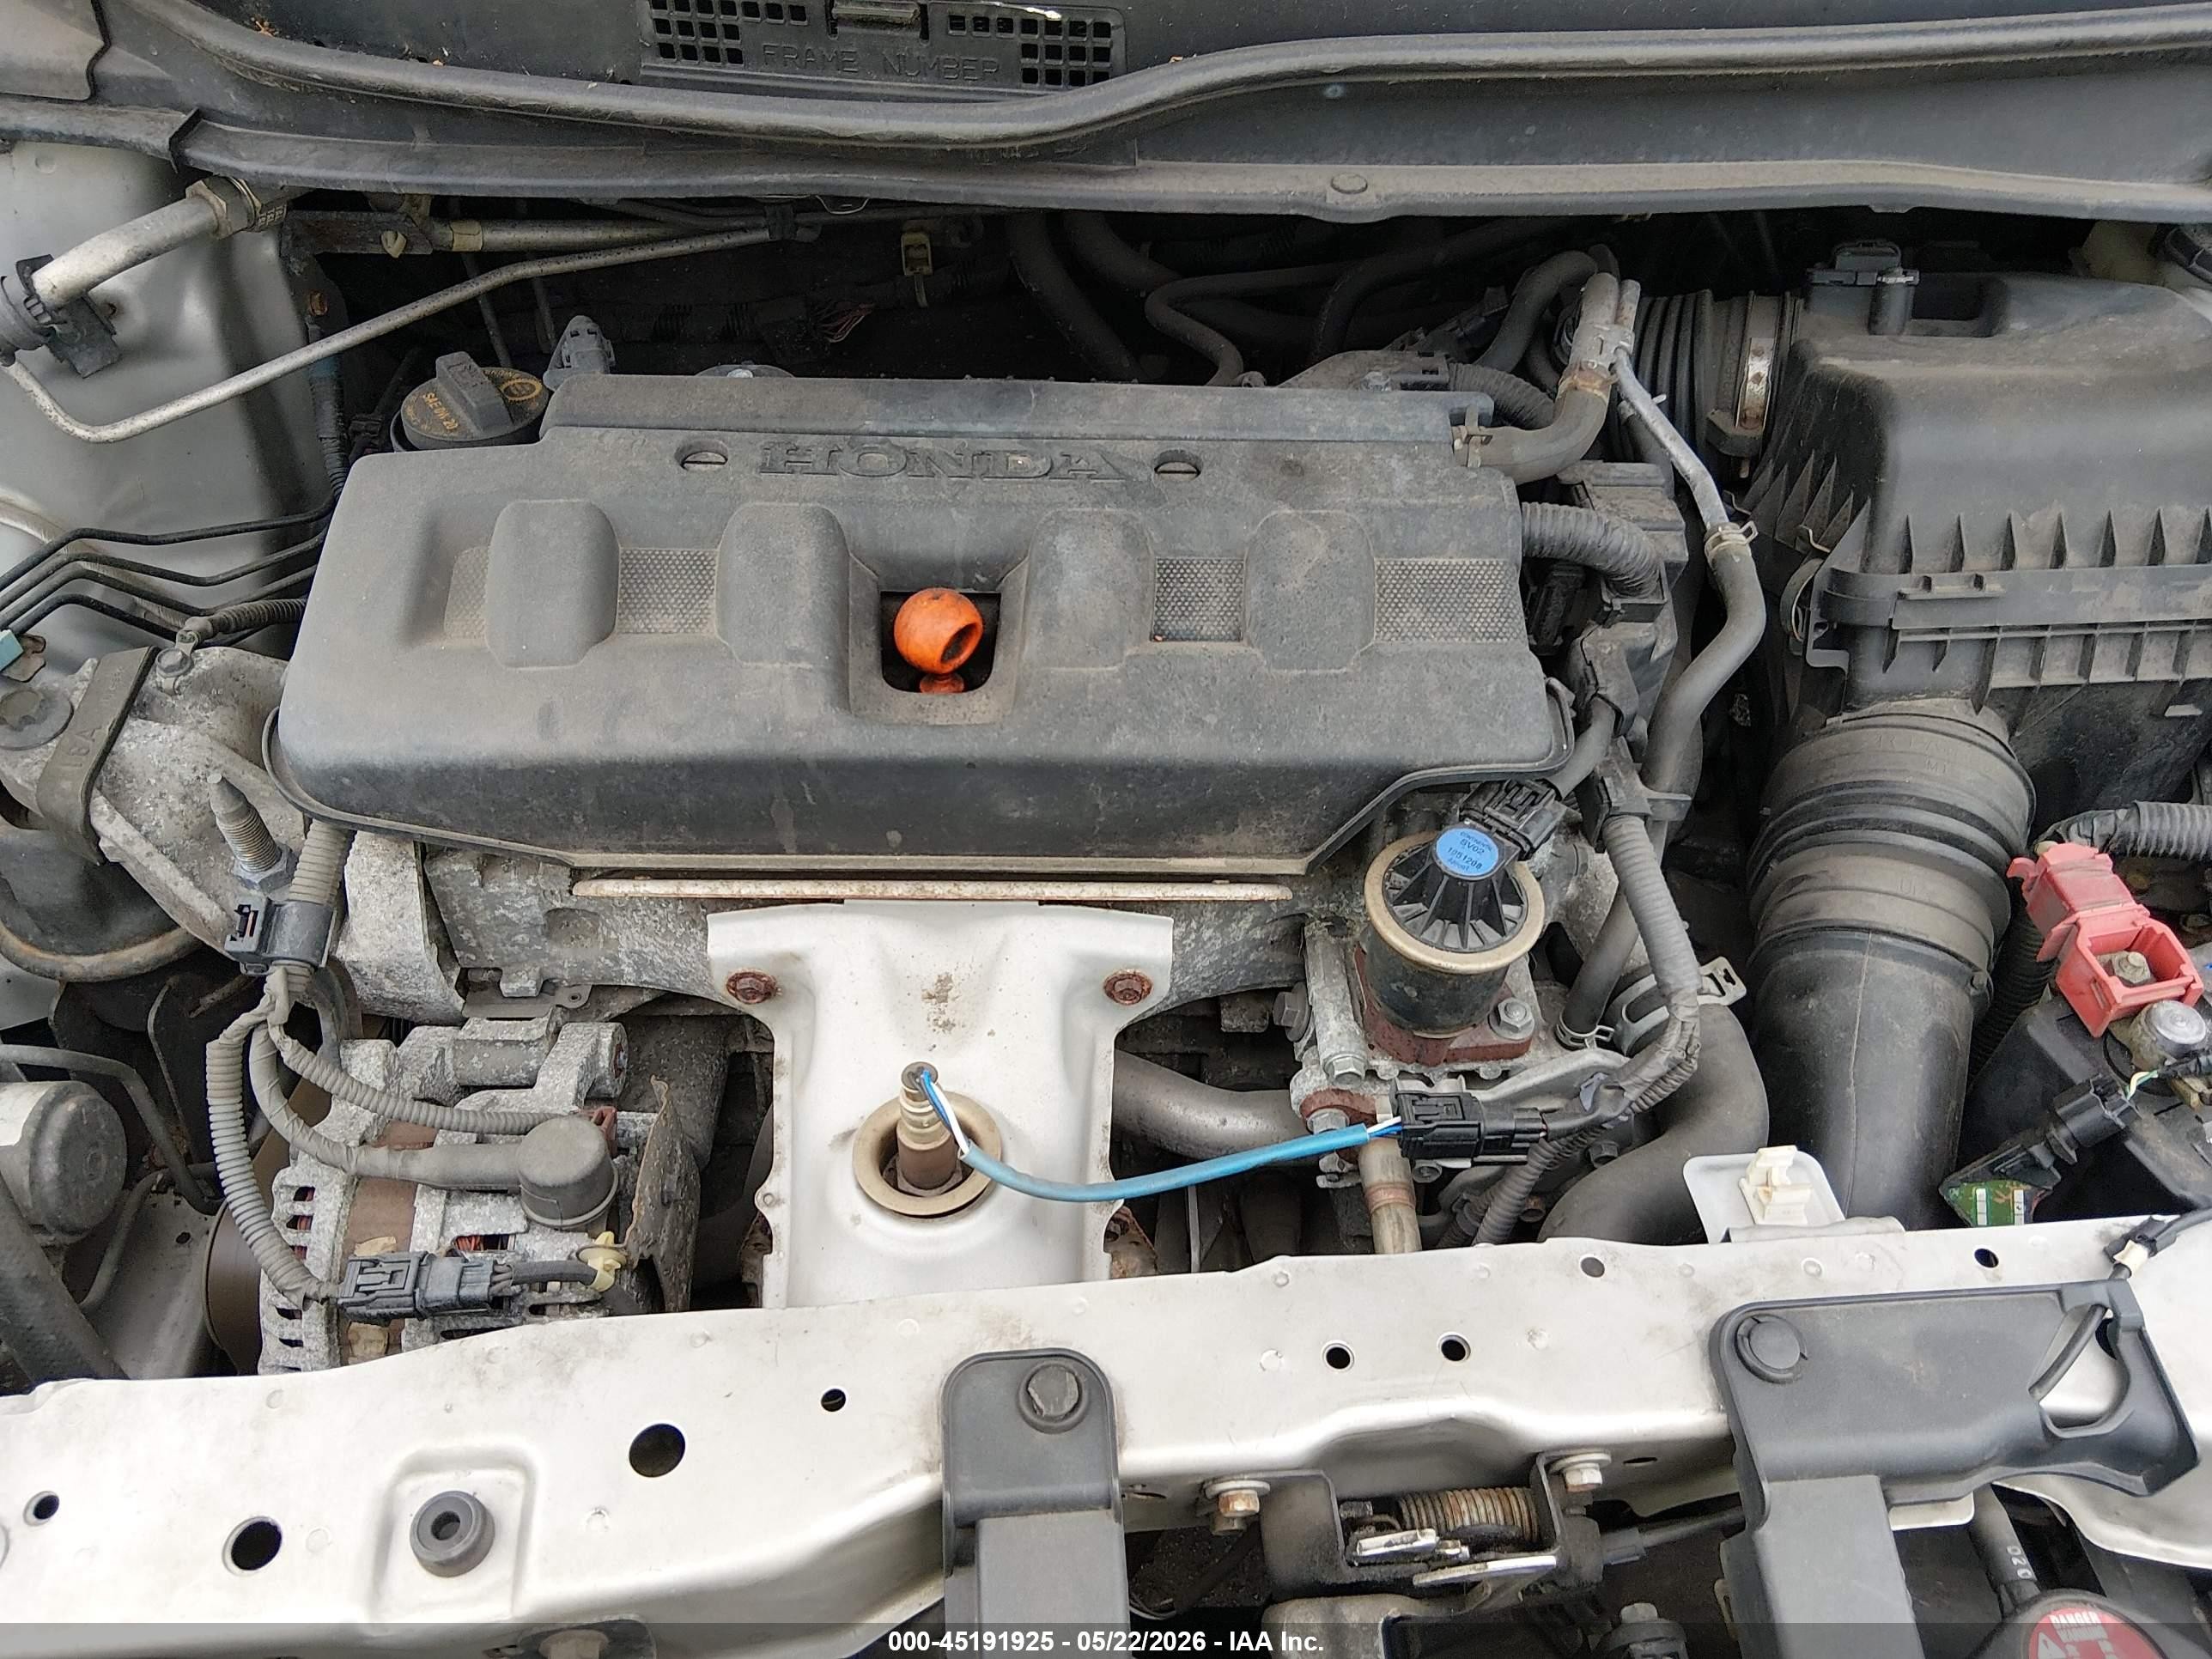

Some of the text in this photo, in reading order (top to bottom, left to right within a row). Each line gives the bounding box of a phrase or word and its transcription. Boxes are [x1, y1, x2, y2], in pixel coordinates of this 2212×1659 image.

[763, 44, 1000, 83] FRAME NUMBER
[760, 445, 1127, 483] HONDA
[2048, 1611, 2103, 1630] DANGER
